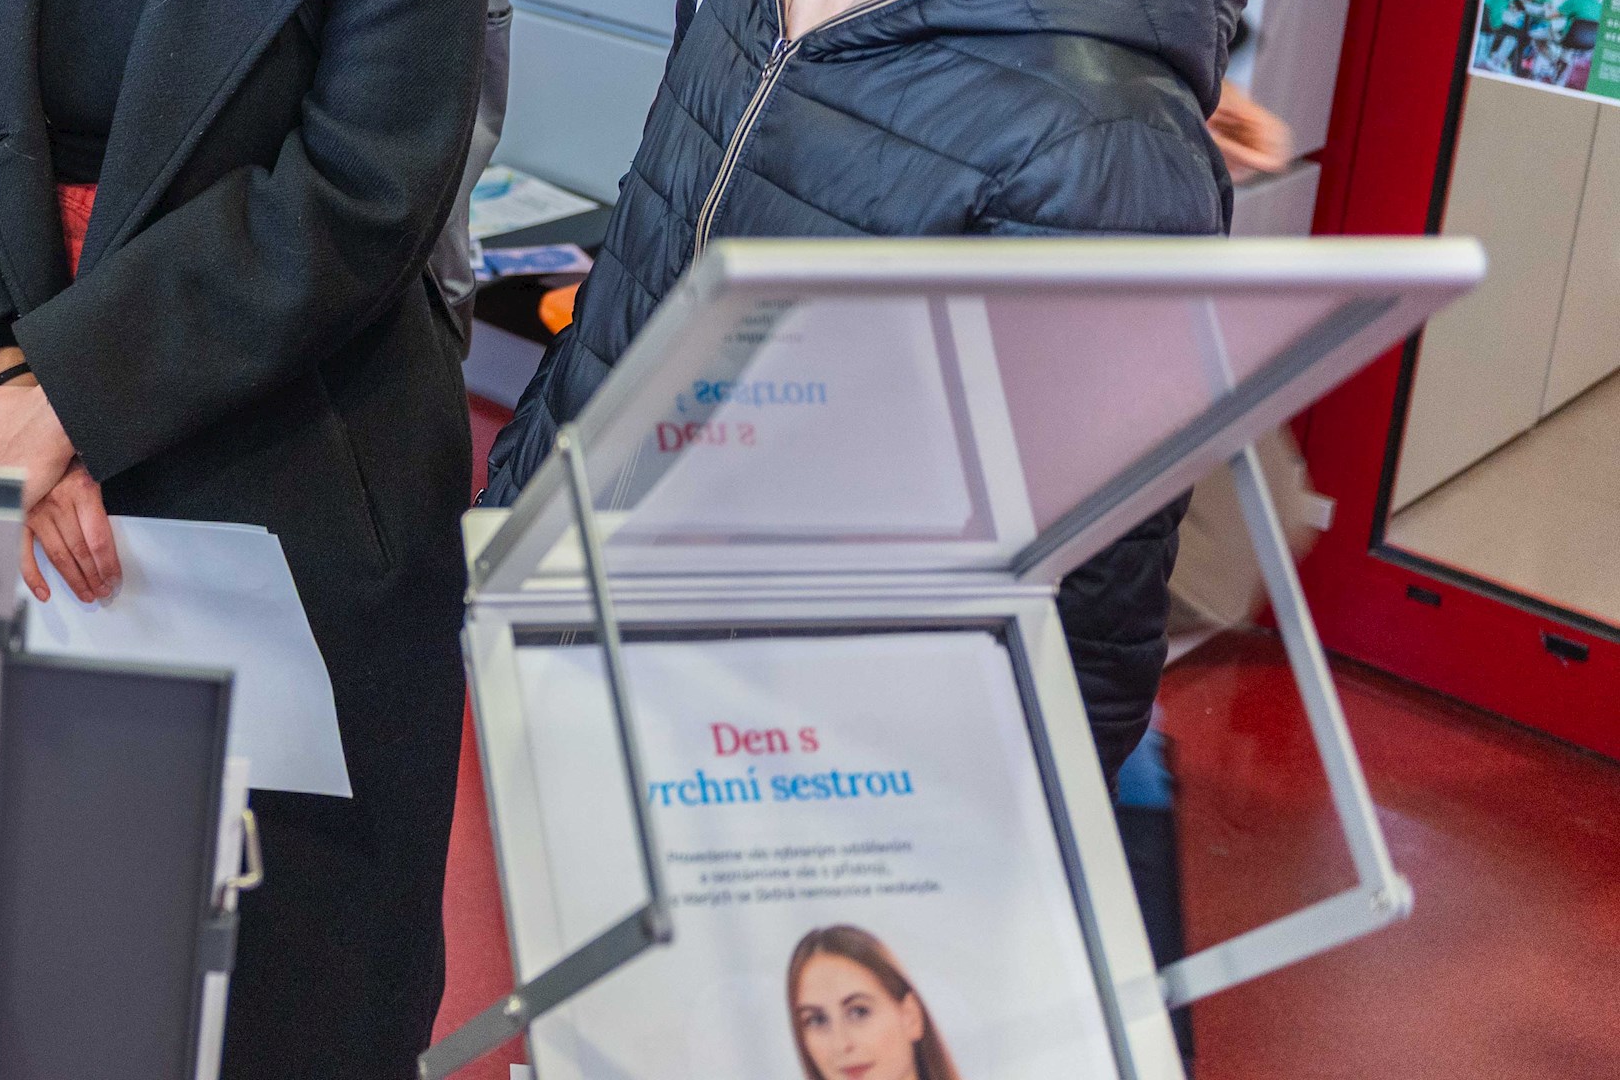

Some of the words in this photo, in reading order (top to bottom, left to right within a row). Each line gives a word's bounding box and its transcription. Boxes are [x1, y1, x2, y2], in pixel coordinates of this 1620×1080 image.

[711, 723, 789, 756] Den
[798, 726, 820, 753] s
[771, 770, 913, 801] sestrou
